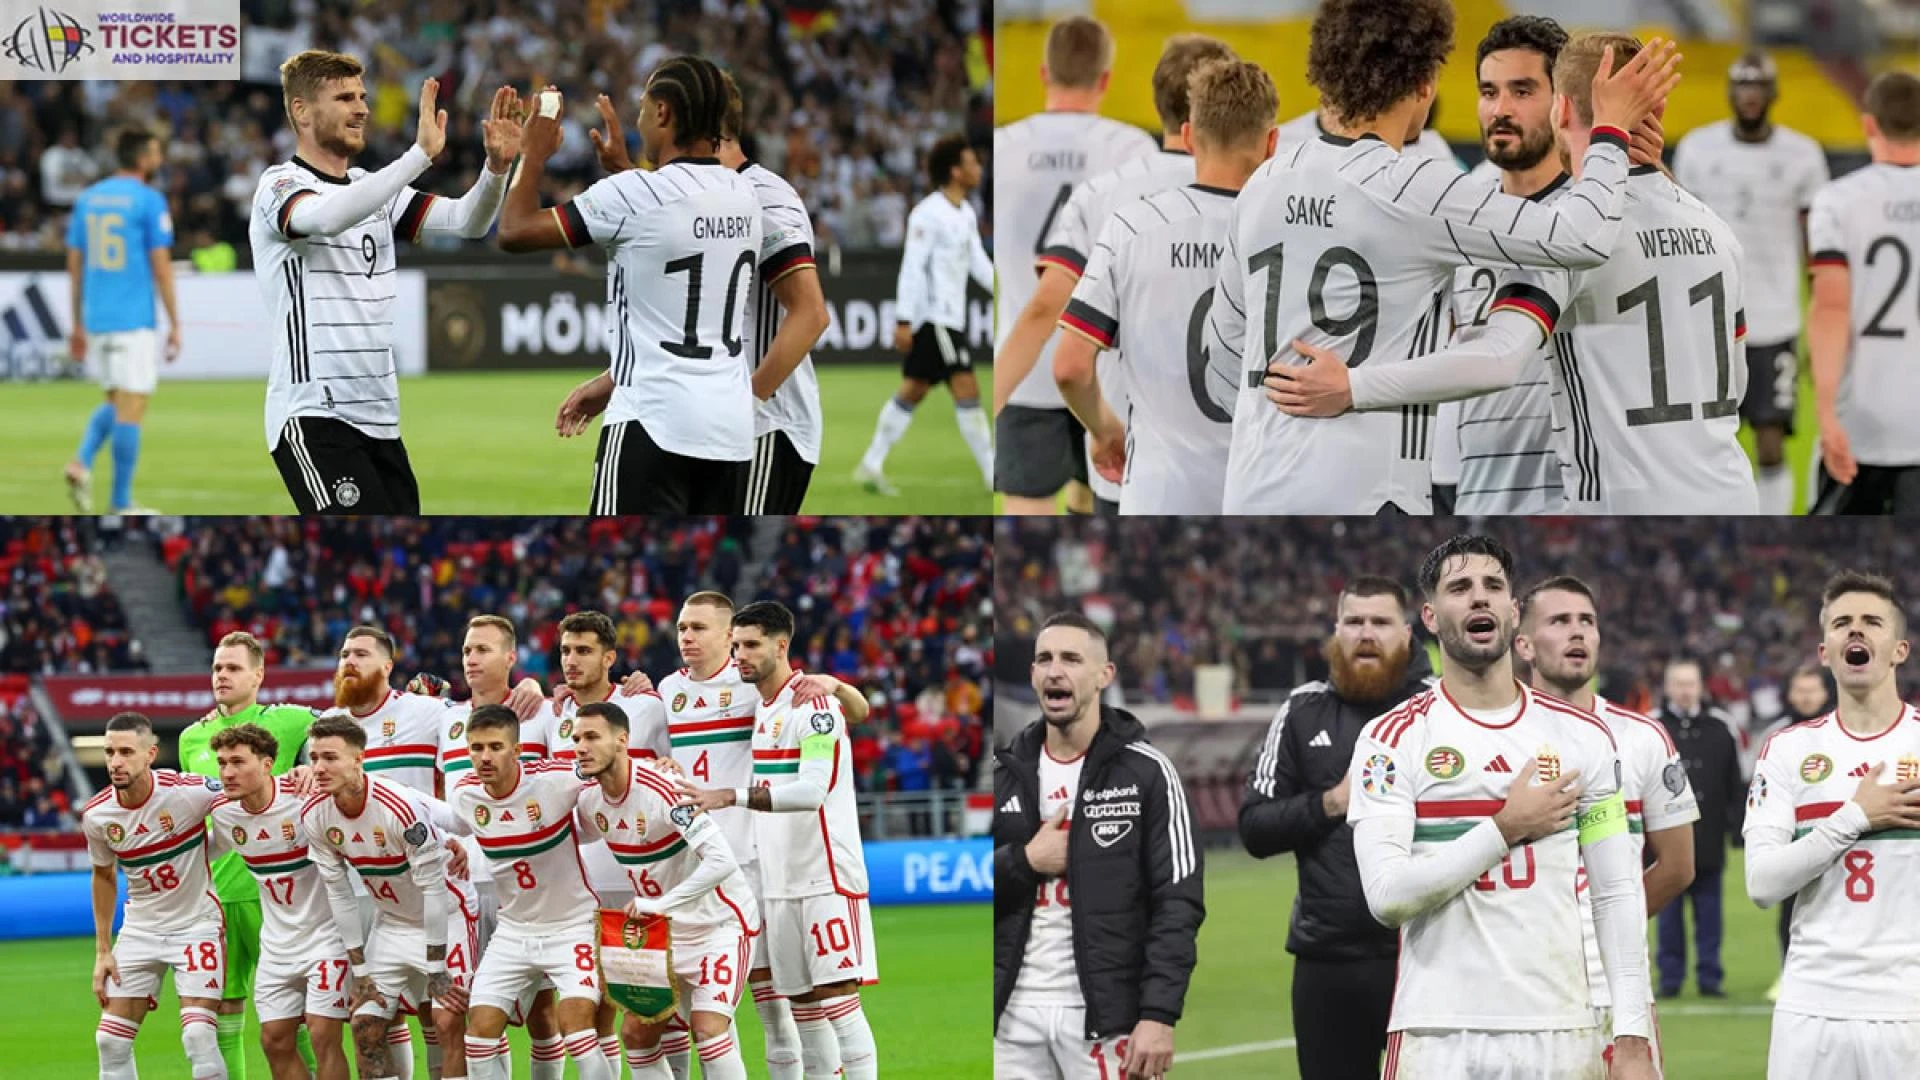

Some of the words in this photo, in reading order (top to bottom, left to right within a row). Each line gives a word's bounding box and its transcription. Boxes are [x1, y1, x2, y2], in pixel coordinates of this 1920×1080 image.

[1285, 194, 1334, 228] SANÉ
[85, 213, 126, 271] 16
[693, 216, 752, 239] GNABRY
[1636, 229, 1717, 258] WERNER
[361, 233, 378, 279] 9
[1861, 235, 1920, 338] 2
[659, 250, 755, 359] 10
[1247, 242, 1379, 388] 19
[1616, 271, 1738, 426] 11
[692, 750, 709, 782] 4
[142, 864, 179, 893] 18
[264, 876, 294, 905] 17
[512, 860, 536, 890] 8
[627, 869, 662, 897] 16
[1844, 850, 1874, 902] 8
[363, 879, 399, 904] 14
[810, 917, 850, 957] 10
[183, 942, 218, 971] 18
[574, 943, 593, 971] 8
[699, 953, 732, 985] 16
[317, 959, 348, 991] 17
